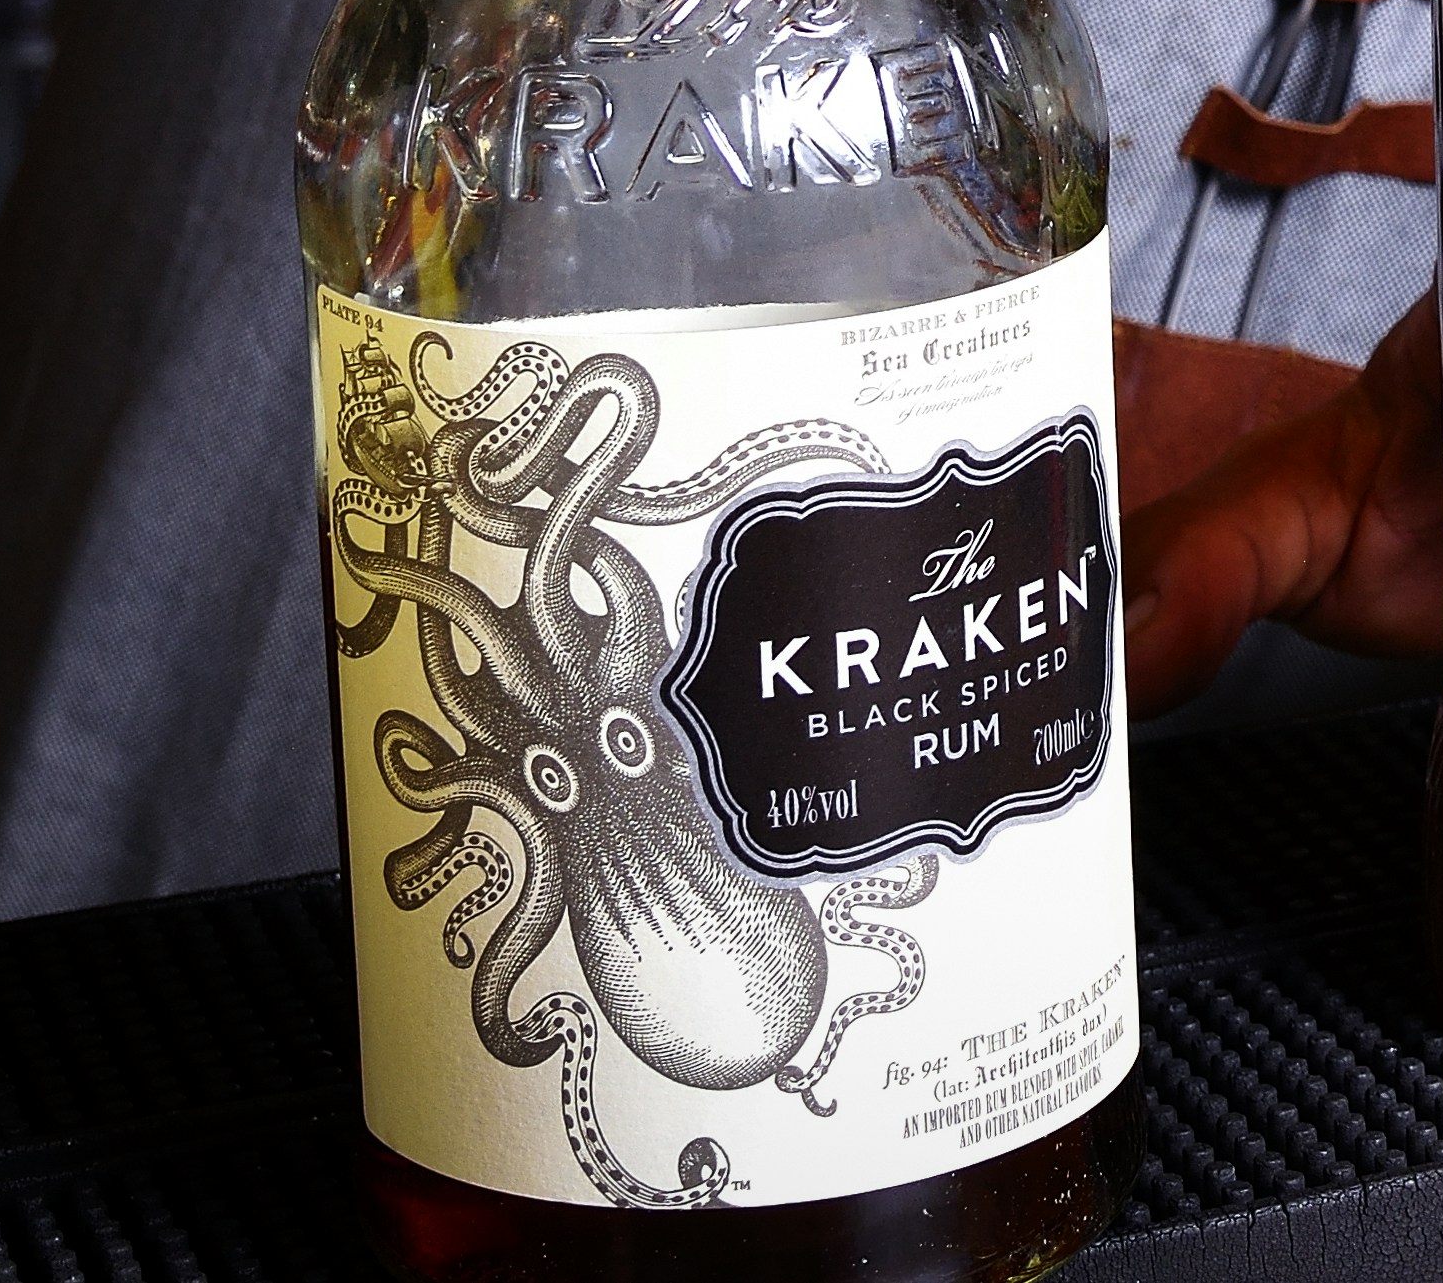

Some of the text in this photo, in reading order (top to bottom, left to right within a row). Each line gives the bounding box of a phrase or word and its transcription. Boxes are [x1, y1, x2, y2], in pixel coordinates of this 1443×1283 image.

[402, 24, 1042, 203] KRAKEN
[322, 295, 383, 332] PLATE 94
[840, 285, 1041, 346] BIZARRE & FIERCE
[861, 318, 1033, 378] Sea Creatures
[908, 517, 998, 602] The
[808, 646, 1068, 738] BLACK SPICED
[912, 712, 1000, 769] RUM
[882, 1062, 916, 1090] fig.
[921, 1055, 948, 1078] 94:
[961, 1021, 1028, 1062] THE
[903, 1114, 919, 1139] AN
[924, 1097, 981, 1133] IMPORTED
[985, 1088, 1008, 1114] RUM
[1011, 1067, 1054, 1104] BLENDED
[1055, 1054, 1077, 1084] WITH
[933, 1079, 969, 1103] (lat:
[959, 1062, 1103, 1149] AND OTHER NATURAL FLAVOURS
